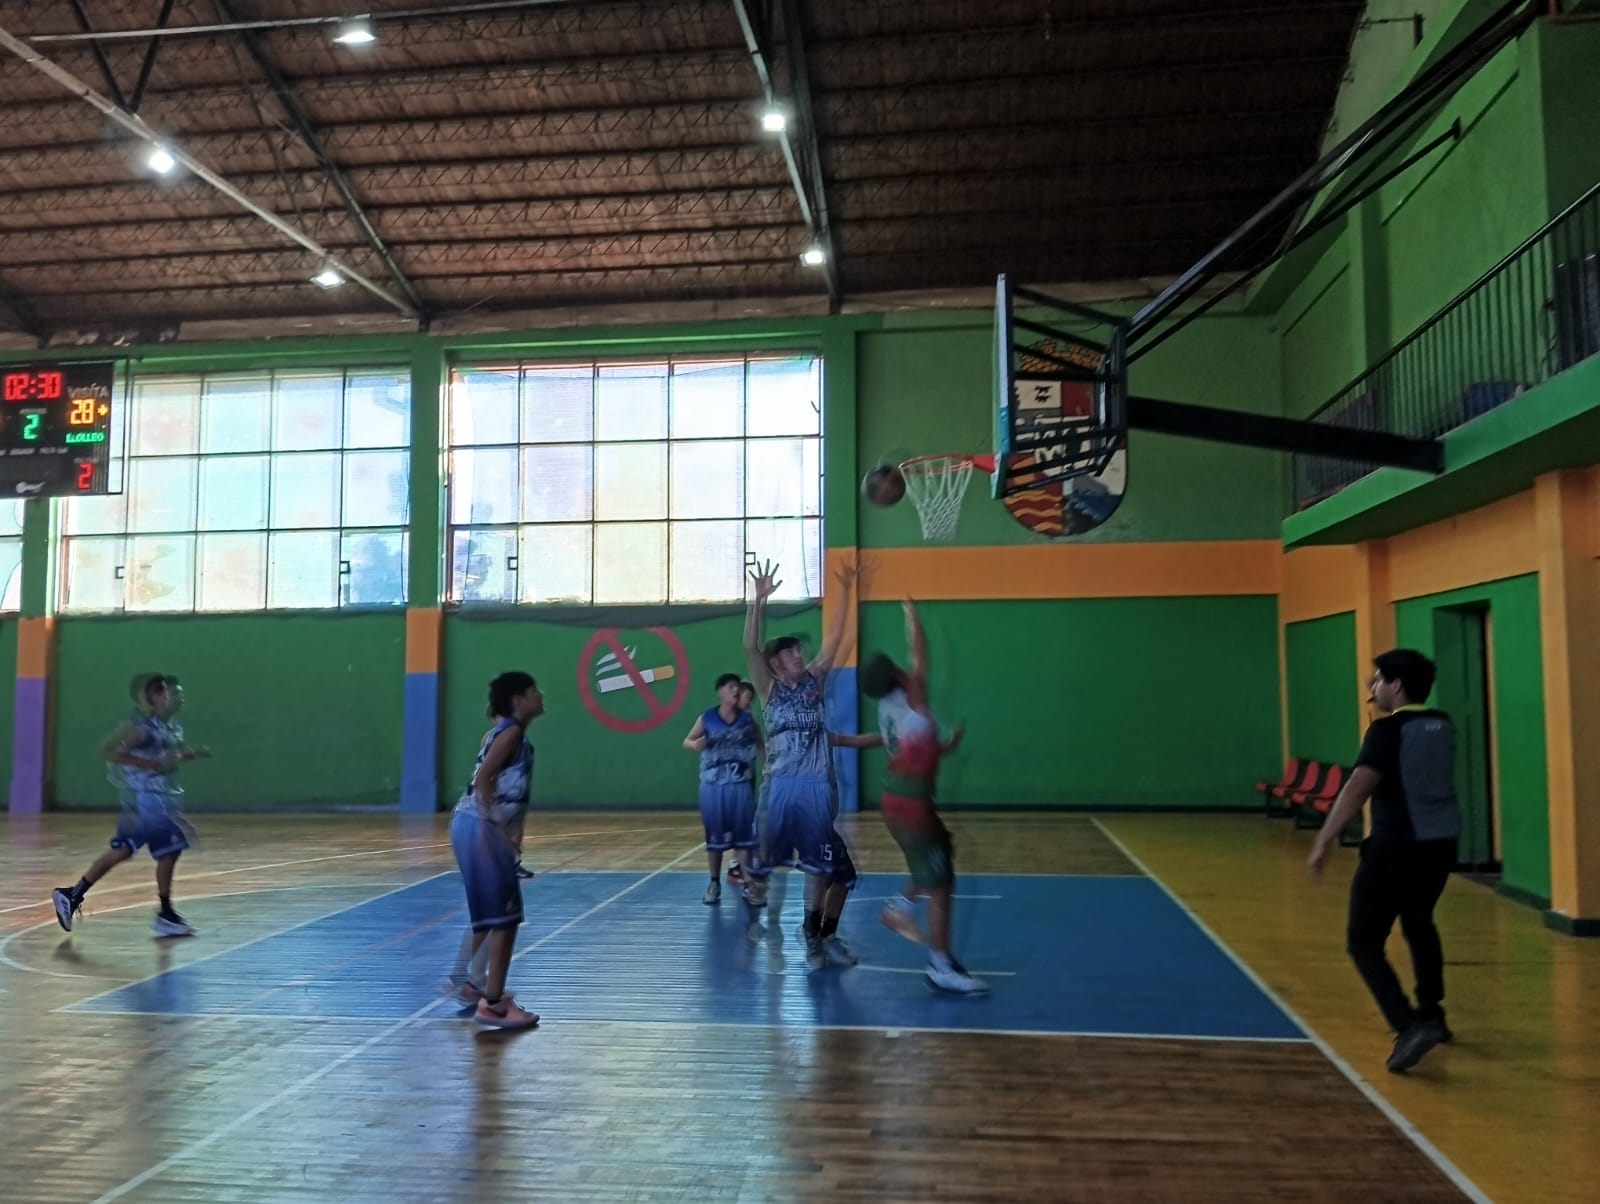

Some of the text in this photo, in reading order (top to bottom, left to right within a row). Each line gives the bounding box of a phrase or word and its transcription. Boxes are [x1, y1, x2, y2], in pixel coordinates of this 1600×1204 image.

[5, 372, 62, 400] 02:30
[70, 399, 95, 425] 28
[24, 414, 39, 440] 2
[78, 463, 93, 489] 2
[724, 762, 740, 779] 12
[818, 843, 833, 862] 15
